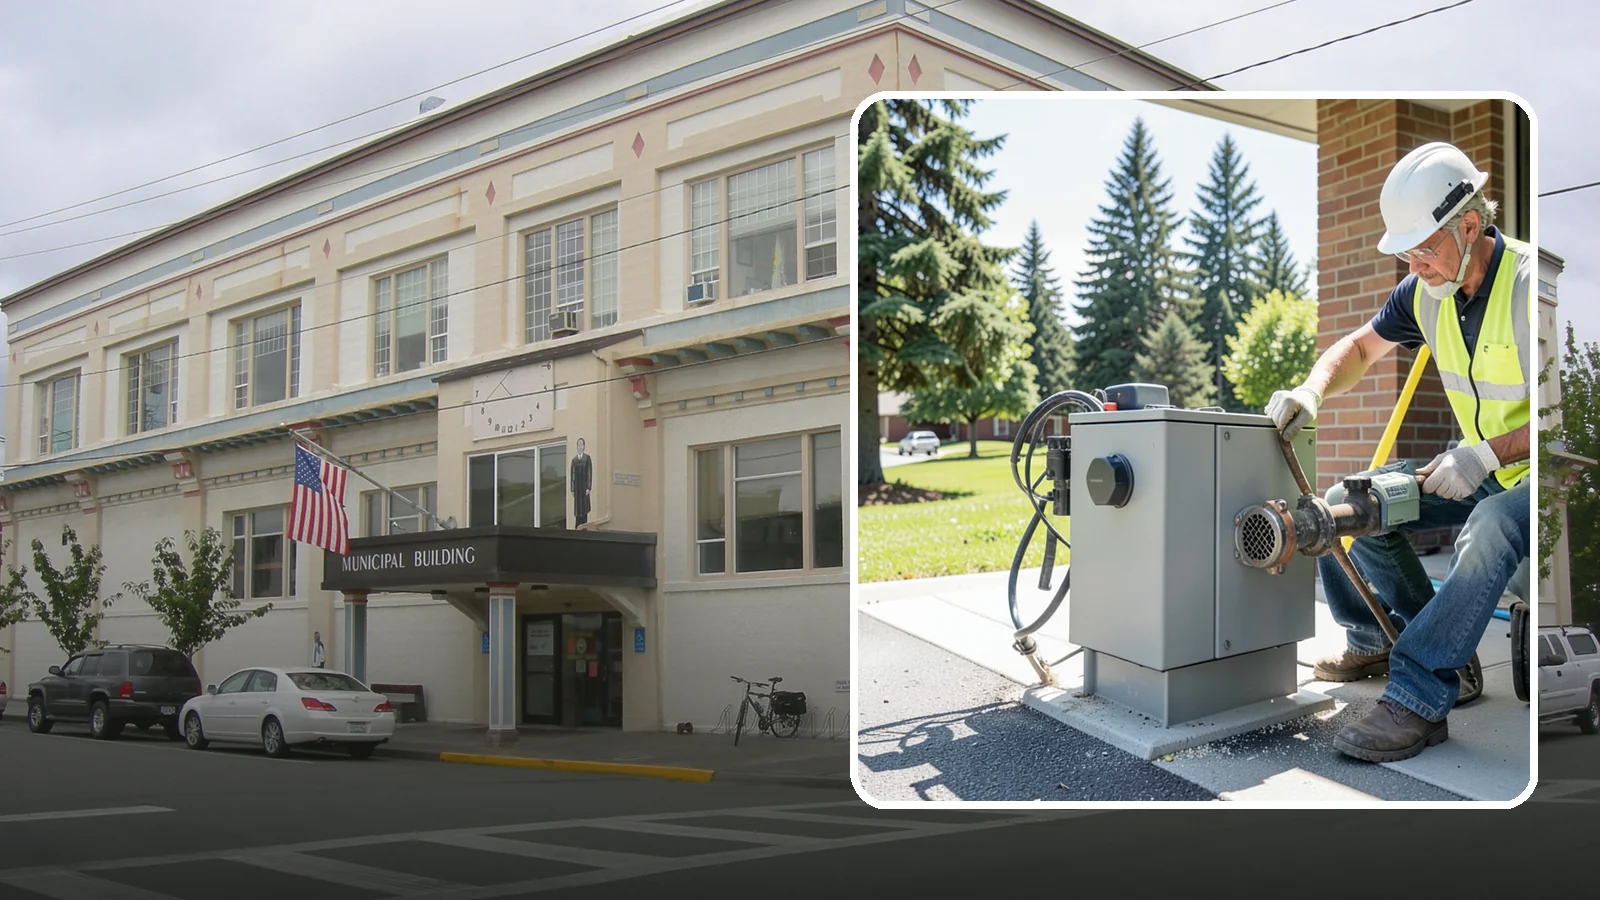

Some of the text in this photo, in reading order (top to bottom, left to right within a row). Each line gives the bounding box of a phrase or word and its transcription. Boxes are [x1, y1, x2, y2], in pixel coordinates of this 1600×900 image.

[536, 402, 540, 410] 4
[480, 406, 485, 415] 8
[488, 418, 493, 426] 9
[528, 414, 533, 422] 3
[520, 420, 526, 428] 2
[342, 546, 475, 572] MUNICIPAL BUILDING
